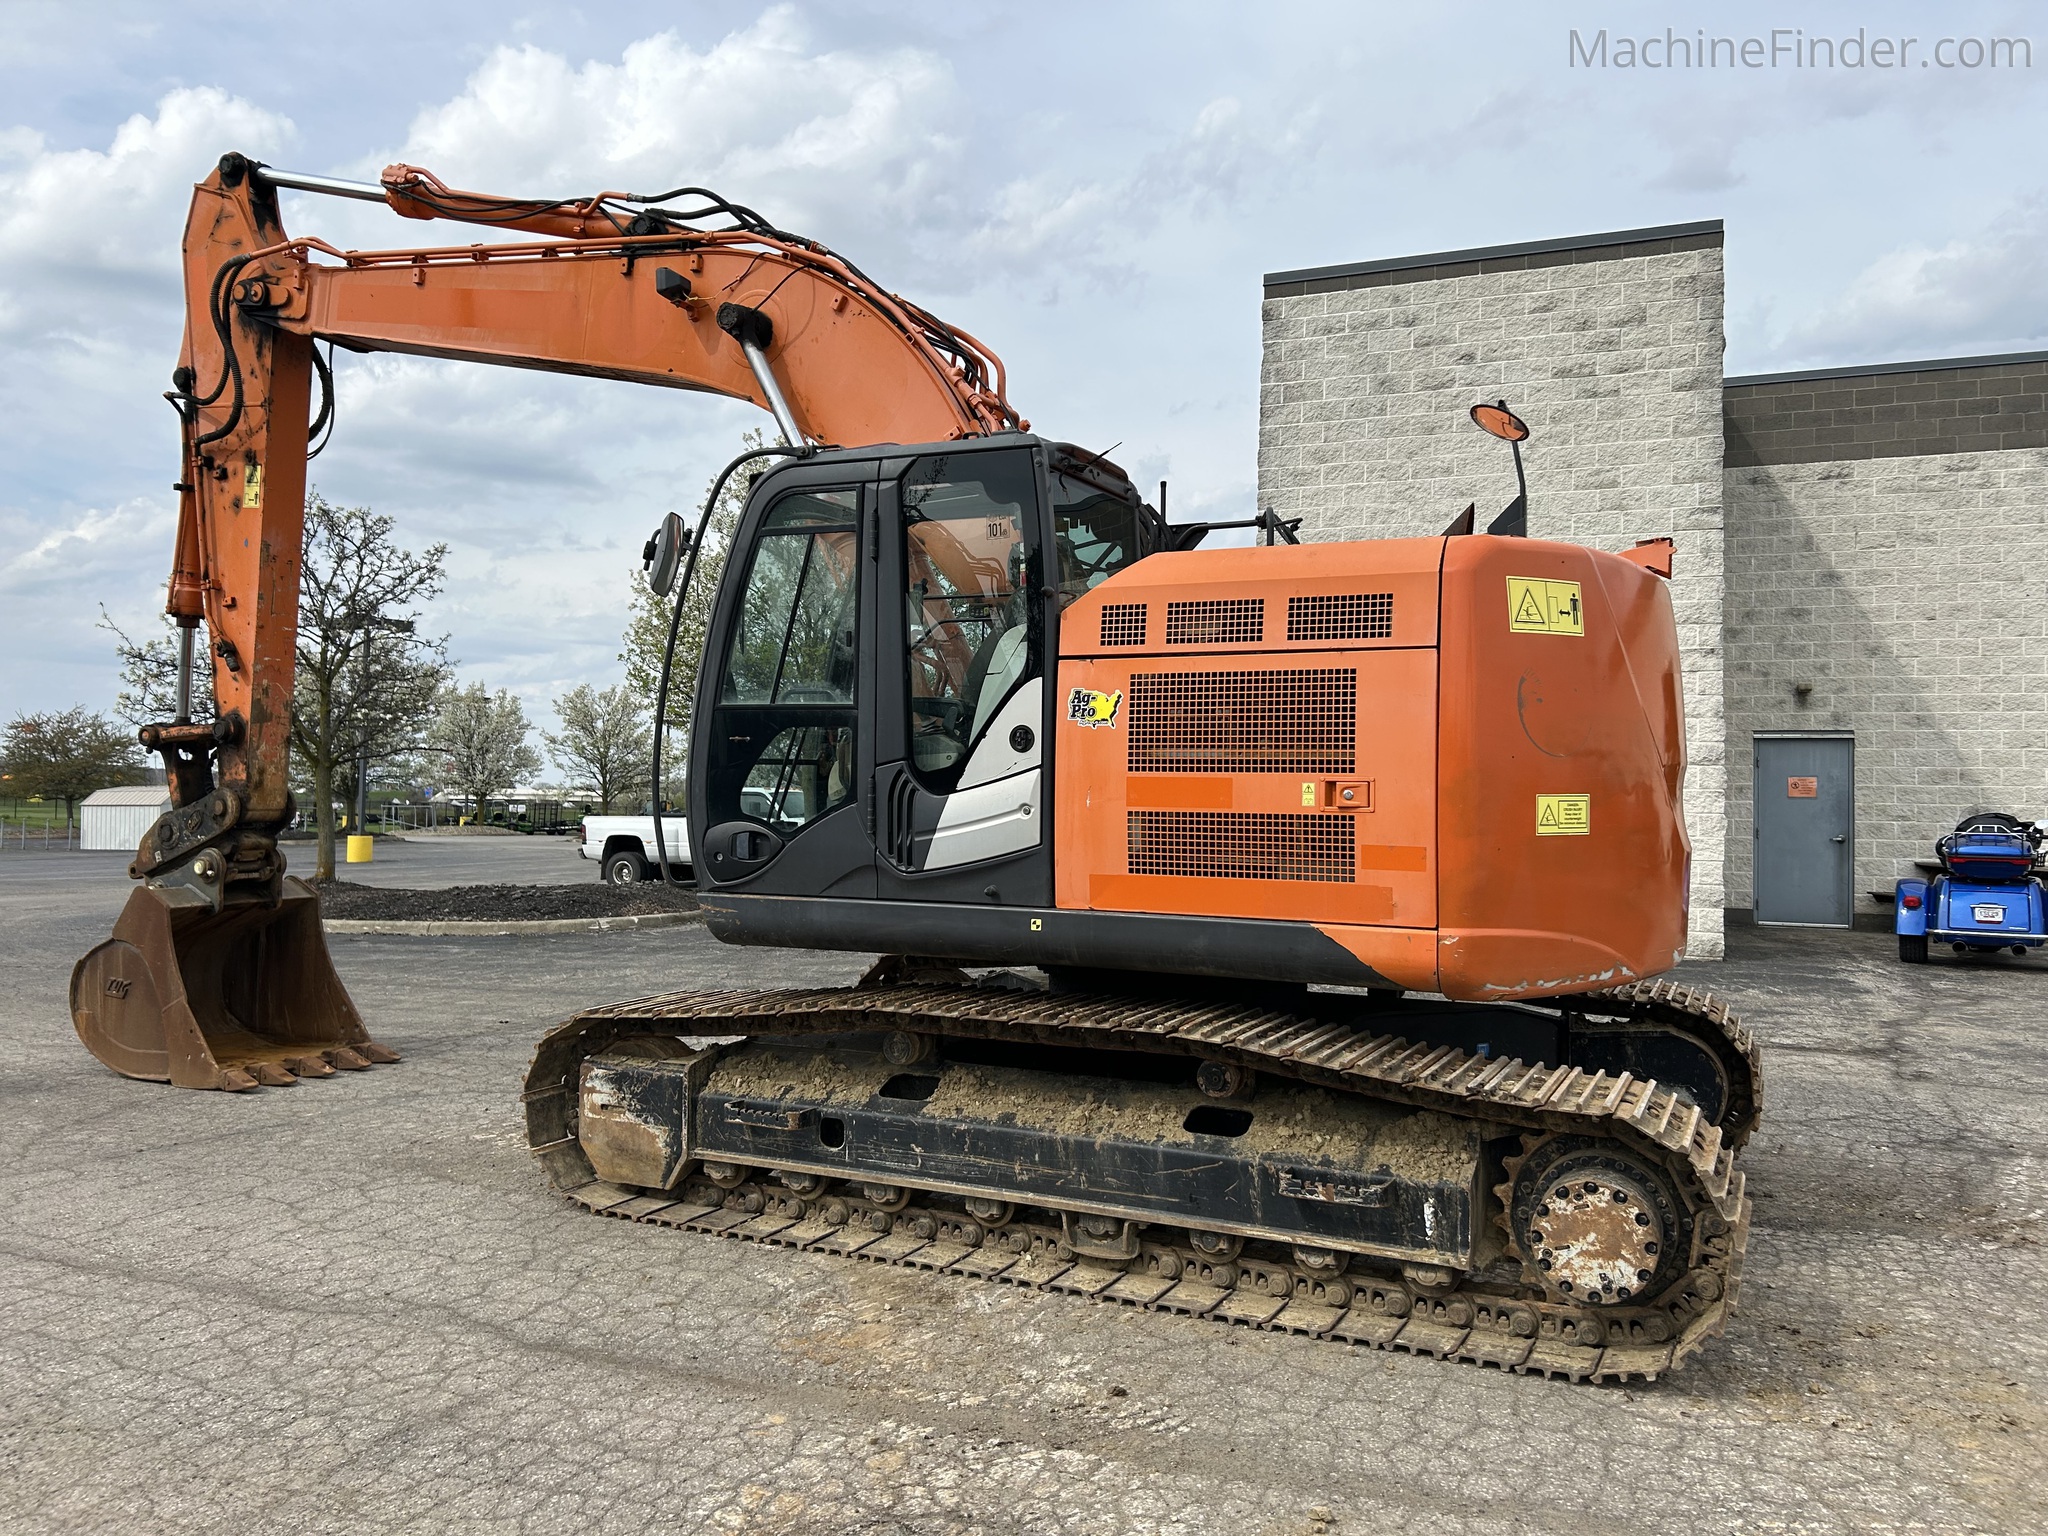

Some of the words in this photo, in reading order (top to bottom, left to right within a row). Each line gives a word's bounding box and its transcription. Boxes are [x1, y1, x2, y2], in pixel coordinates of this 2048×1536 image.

[988, 522, 1002, 537] 101
[1071, 690, 1096, 706] Ag-
[1071, 705, 1096, 718] Pro
